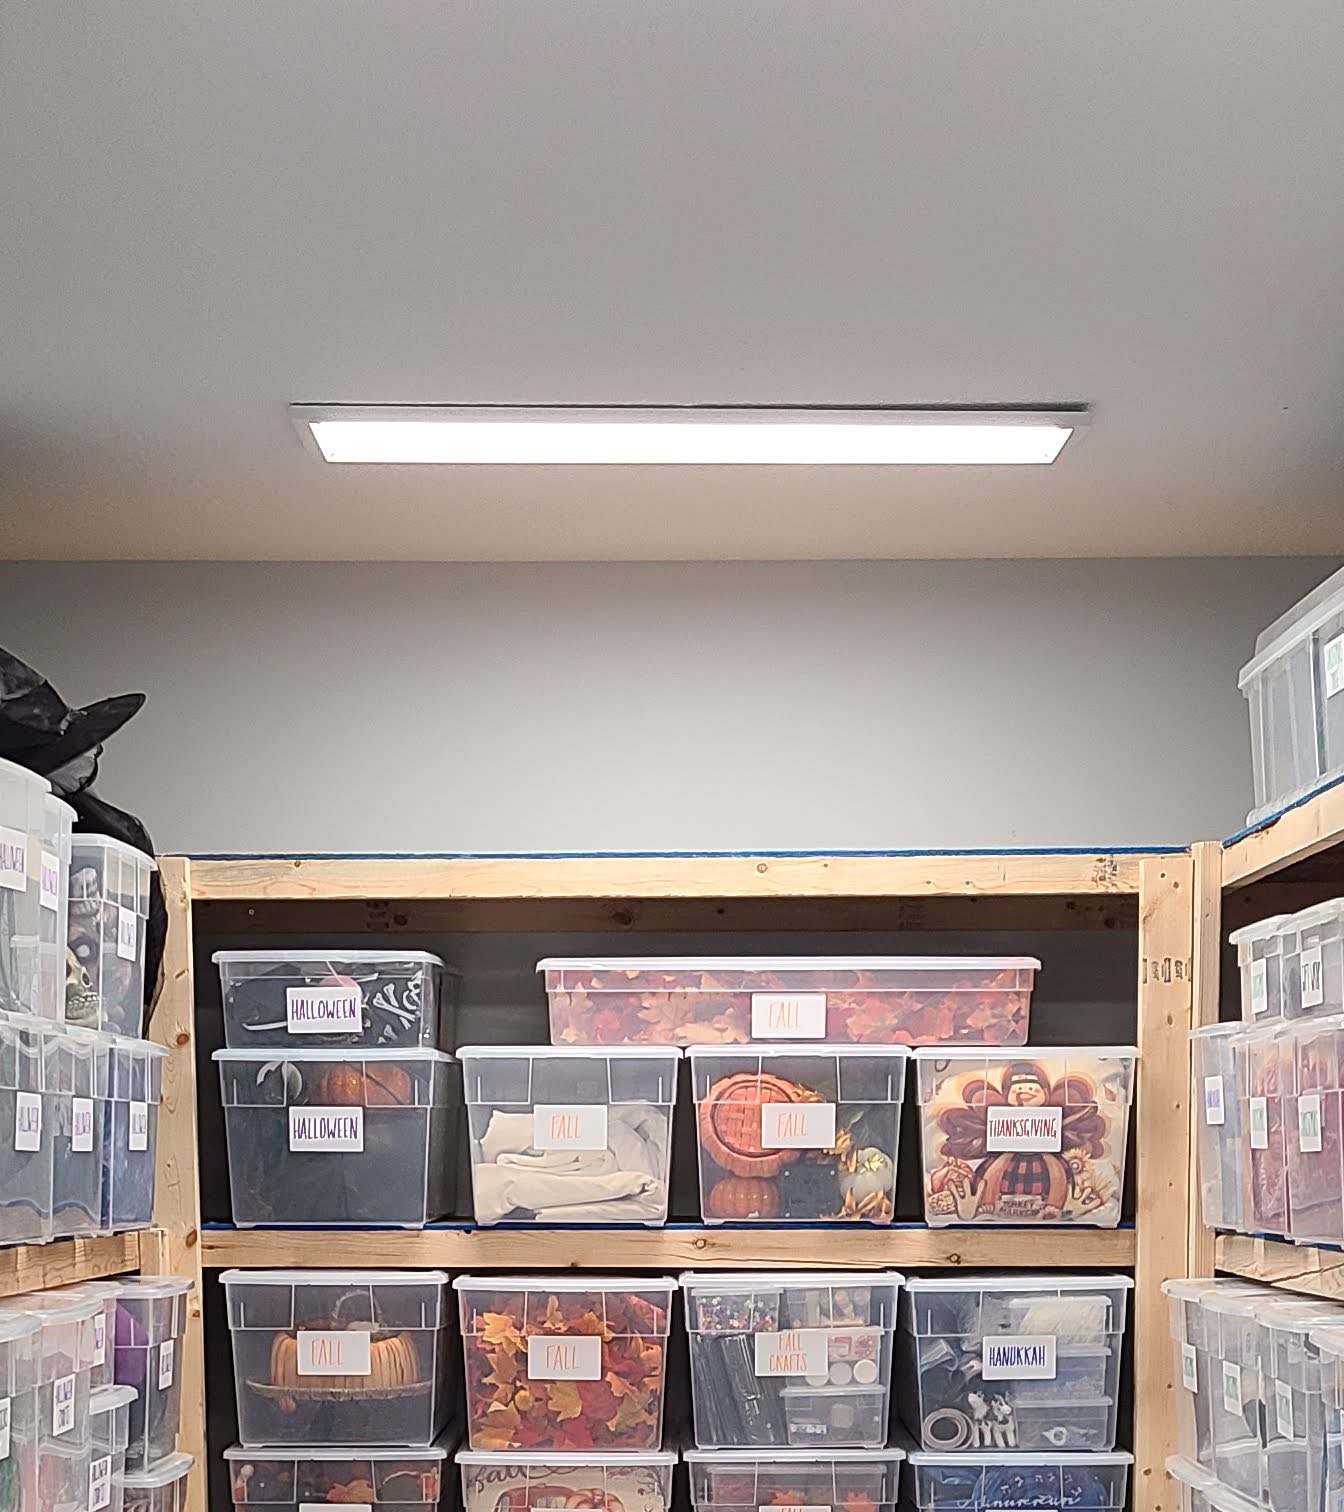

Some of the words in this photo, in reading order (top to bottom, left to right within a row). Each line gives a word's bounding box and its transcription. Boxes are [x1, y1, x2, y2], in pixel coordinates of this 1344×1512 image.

[291, 998, 357, 1022] HALLOWEEN
[769, 1002, 800, 1028] FALL
[292, 1116, 357, 1140] HALLOWEEN
[550, 1115, 582, 1139] FALL
[776, 1112, 808, 1138] FALL
[988, 1117, 1058, 1140] THANKSGIVING
[312, 1339, 344, 1365] FALL
[777, 1333, 802, 1351] FALL
[546, 1344, 580, 1370] FALL
[769, 1353, 807, 1372] CRAFTS
[989, 1345, 1046, 1367] HANUKKAH
